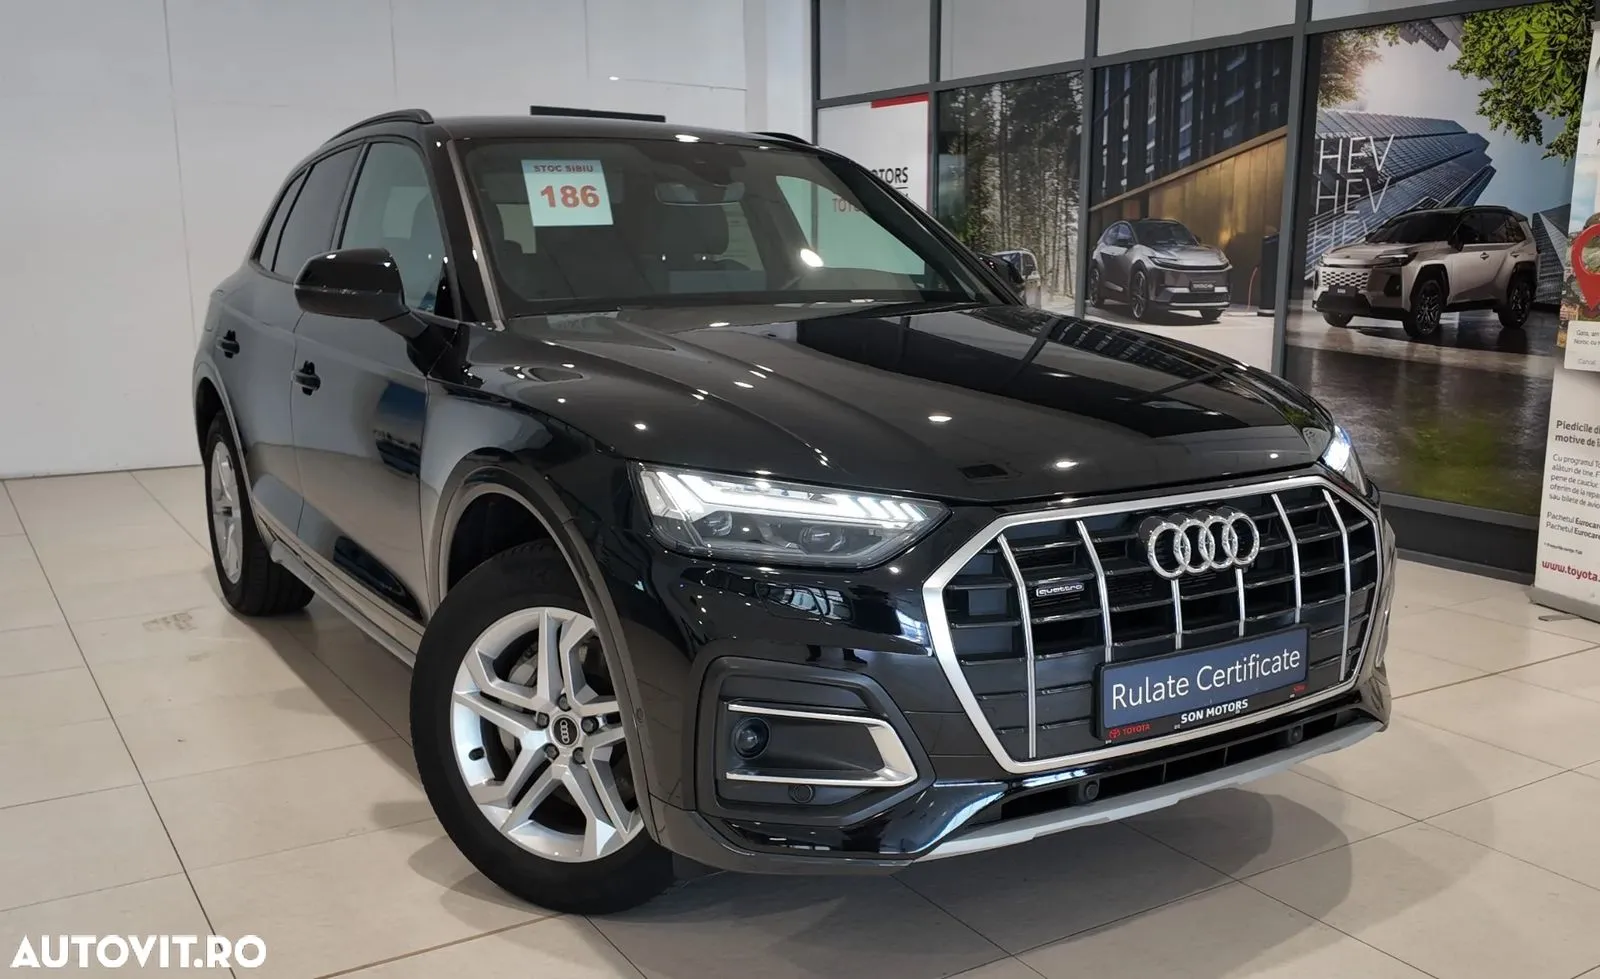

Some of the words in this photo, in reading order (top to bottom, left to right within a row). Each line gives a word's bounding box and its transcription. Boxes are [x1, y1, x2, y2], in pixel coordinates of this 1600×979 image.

[1318, 133, 1395, 175] HEV
[533, 165, 562, 173] STOC
[540, 185, 600, 208] 186
[1315, 176, 1392, 215] HEV
[1556, 419, 1593, 433] Piedicile
[1555, 434, 1585, 445] motive
[1586, 438, 1596, 447] de
[1552, 453, 1562, 462] Cu
[1547, 511, 1575, 524] Pachetul
[1546, 521, 1574, 533] Pachetul
[1039, 584, 1083, 596] quattro
[1112, 676, 1189, 710] Rulate
[1197, 648, 1300, 691] Certificate
[1181, 709, 1204, 724] SON
[1206, 698, 1249, 719] MOTORS
[1122, 723, 1151, 736] TOYOTA
